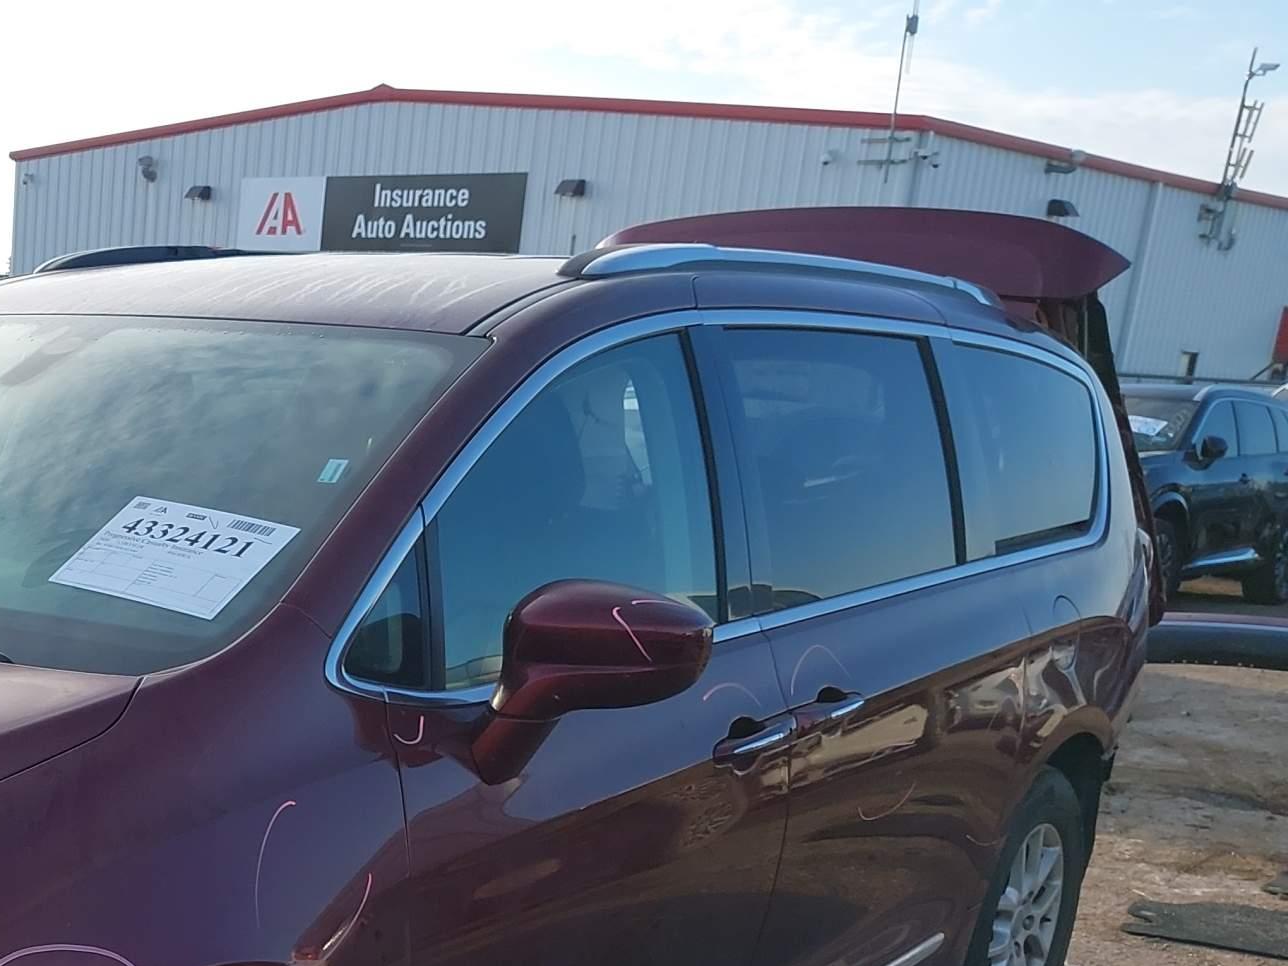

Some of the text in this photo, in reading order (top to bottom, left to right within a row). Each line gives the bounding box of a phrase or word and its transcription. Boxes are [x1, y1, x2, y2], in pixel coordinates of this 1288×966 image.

[373, 182, 469, 209] Insurance
[351, 213, 487, 240] Auto Auctions
[123, 518, 254, 557] 43324121
